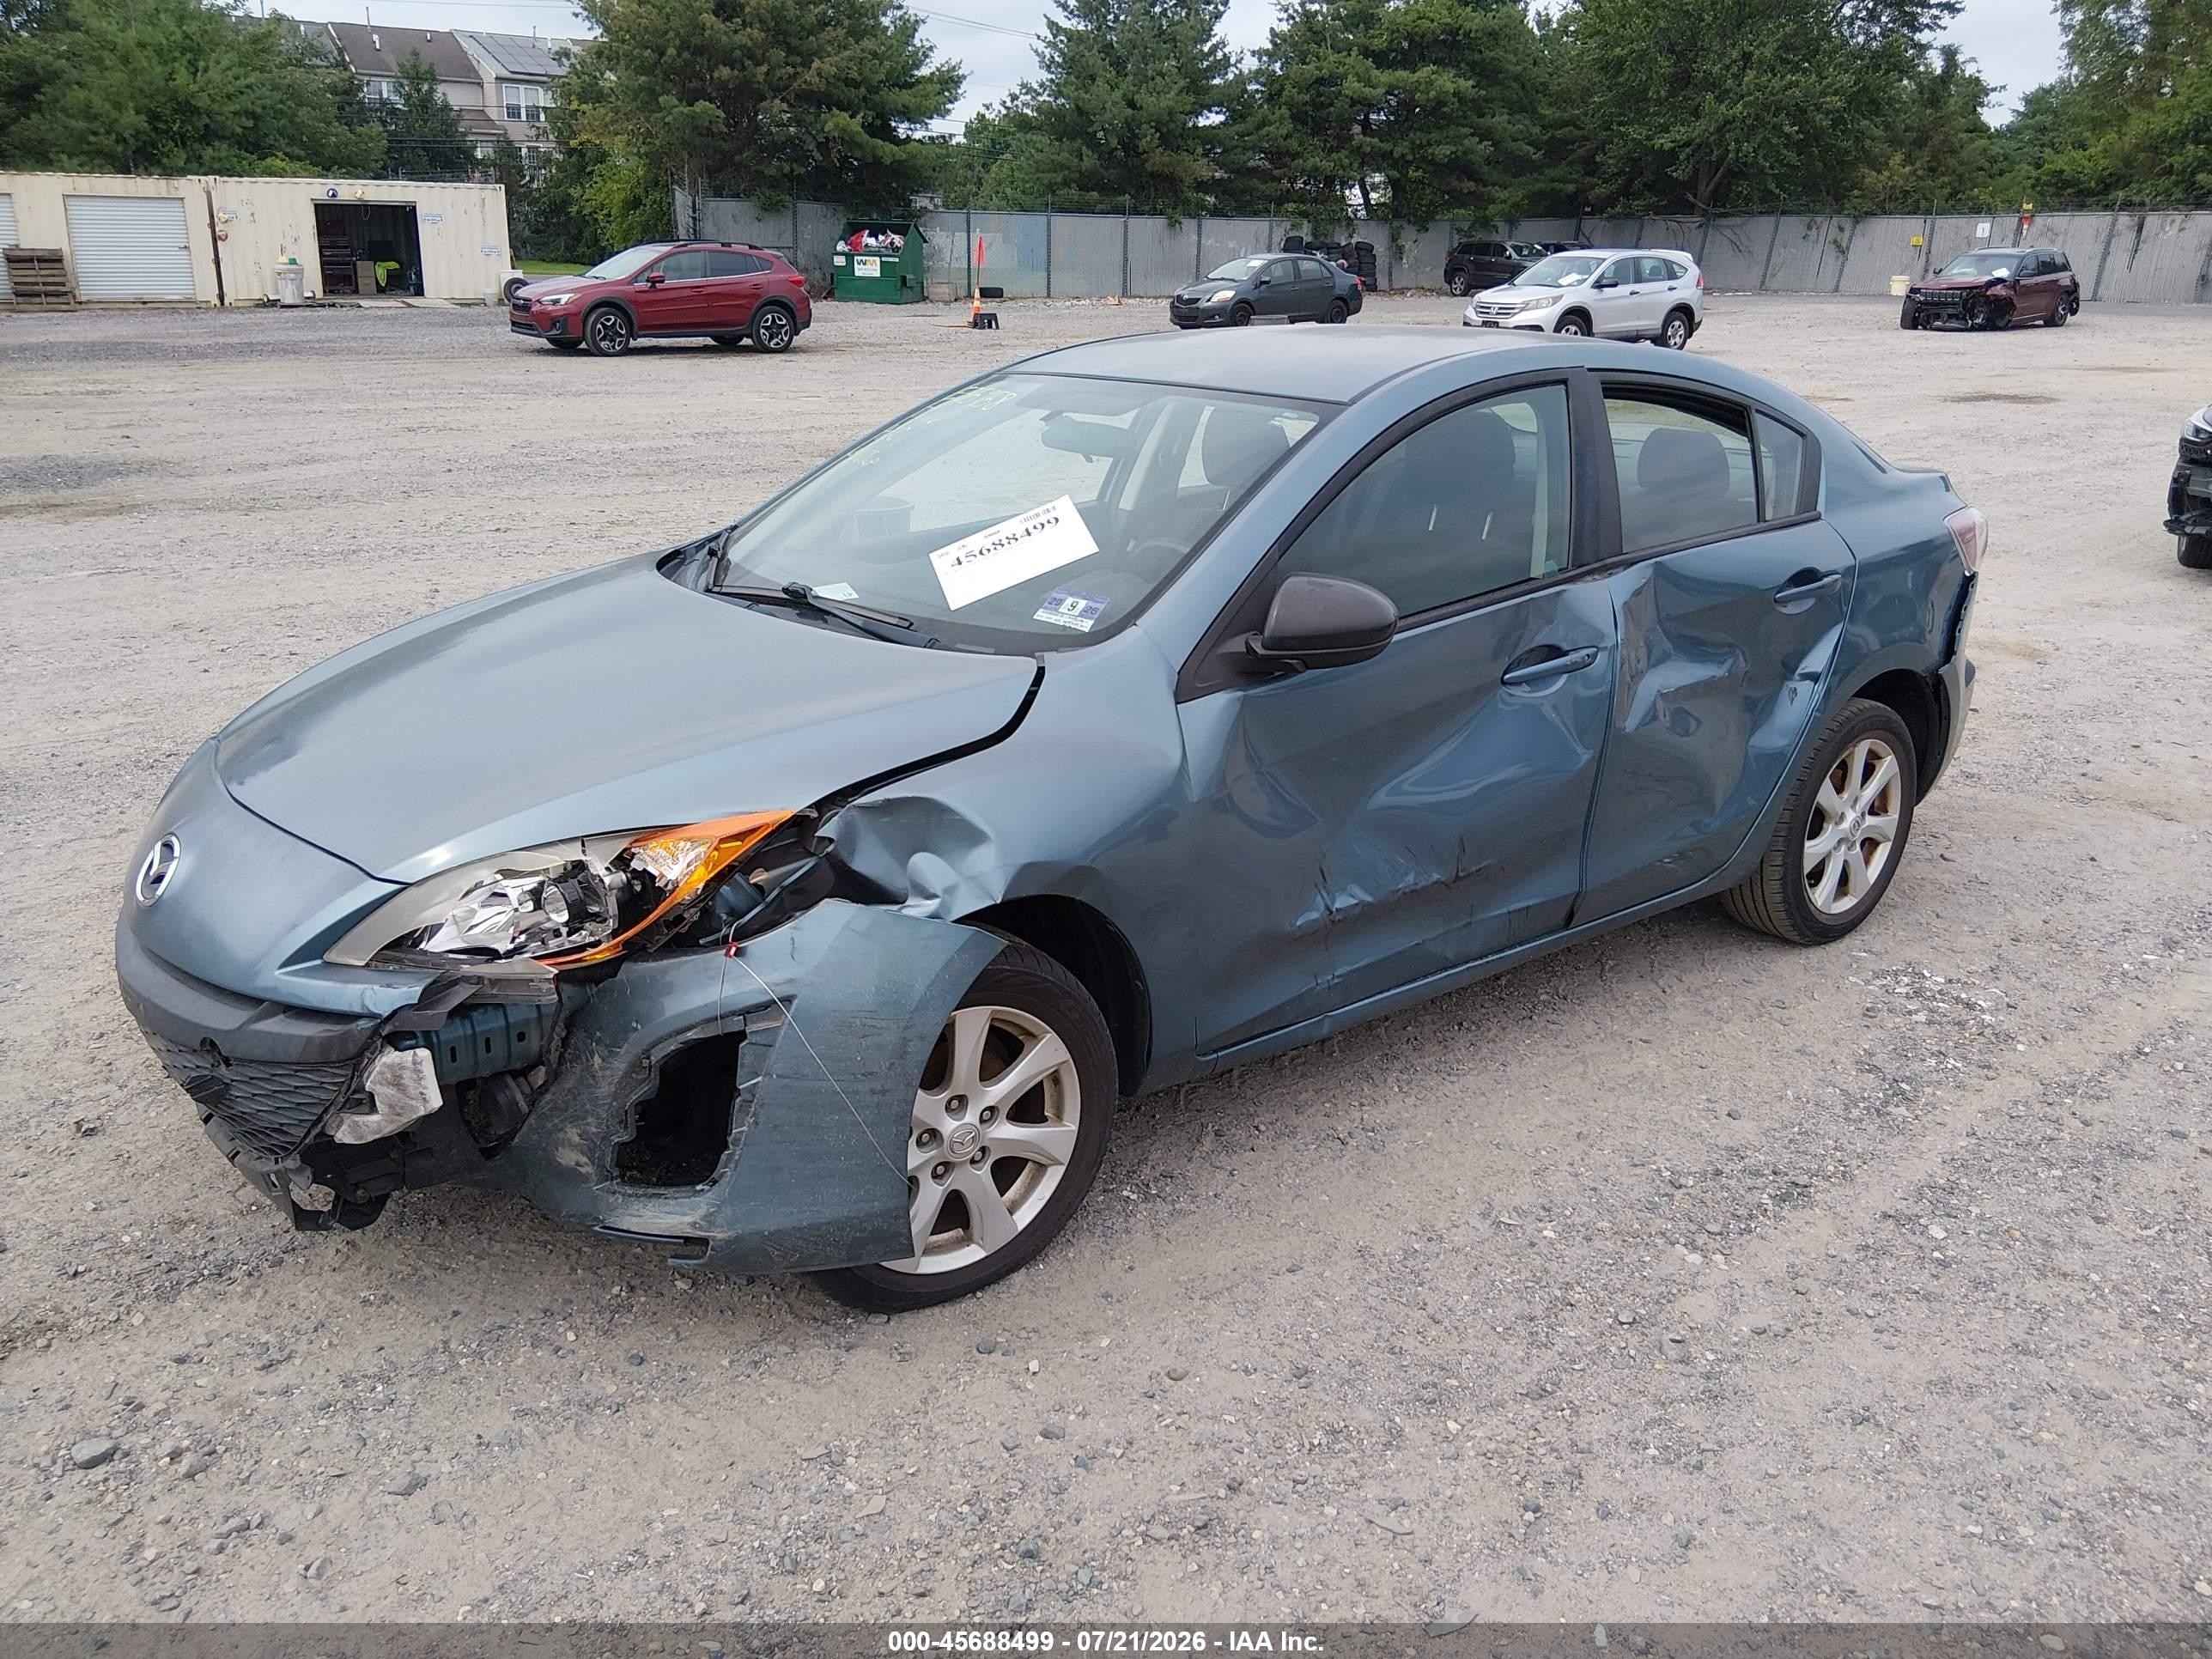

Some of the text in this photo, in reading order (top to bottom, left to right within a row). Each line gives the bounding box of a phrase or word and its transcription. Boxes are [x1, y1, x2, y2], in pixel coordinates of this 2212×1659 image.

[856, 258, 877, 266] WM
[951, 516, 1060, 567] 45688499
[1048, 598, 1099, 615] 20 9 26
